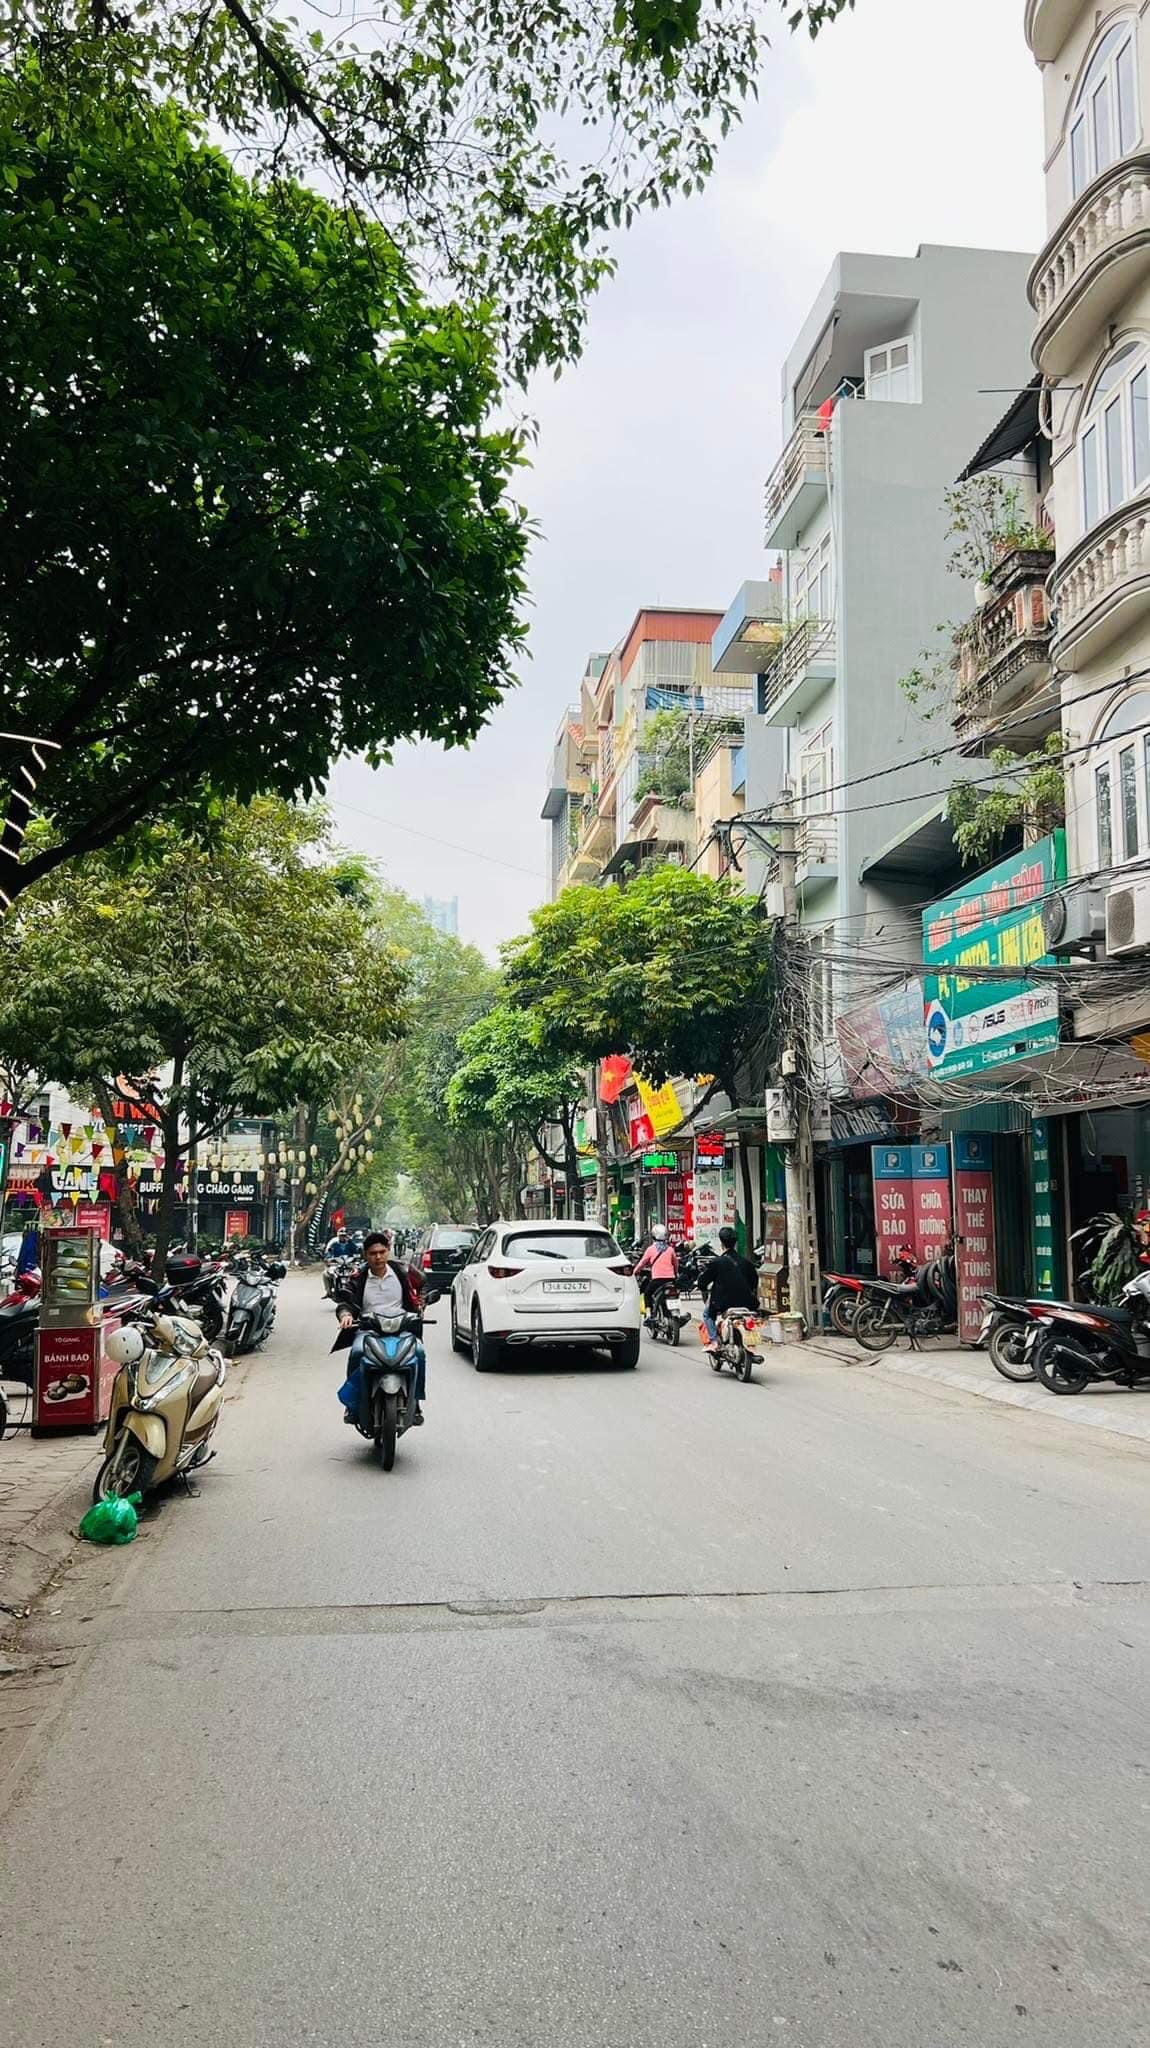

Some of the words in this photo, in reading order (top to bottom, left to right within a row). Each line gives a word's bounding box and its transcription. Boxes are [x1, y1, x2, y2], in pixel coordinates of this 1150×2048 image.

[983, 1010, 1005, 1029] ASUS
[206, 1181, 229, 1194] CHẢO
[231, 1184, 254, 1194] GANG
[962, 1188, 987, 1203] THAY
[881, 1187, 905, 1210] SỬA
[920, 1189, 942, 1209] CHỮA
[882, 1213, 906, 1236] BẢO
[919, 1214, 946, 1236] DƯỠNG
[966, 1207, 985, 1228] THẾ
[966, 1236, 987, 1255] PHỤ
[963, 1259, 991, 1277] TÙNG
[44, 1353, 69, 1363] BÁNH
[70, 1353, 90, 1362] BAO
